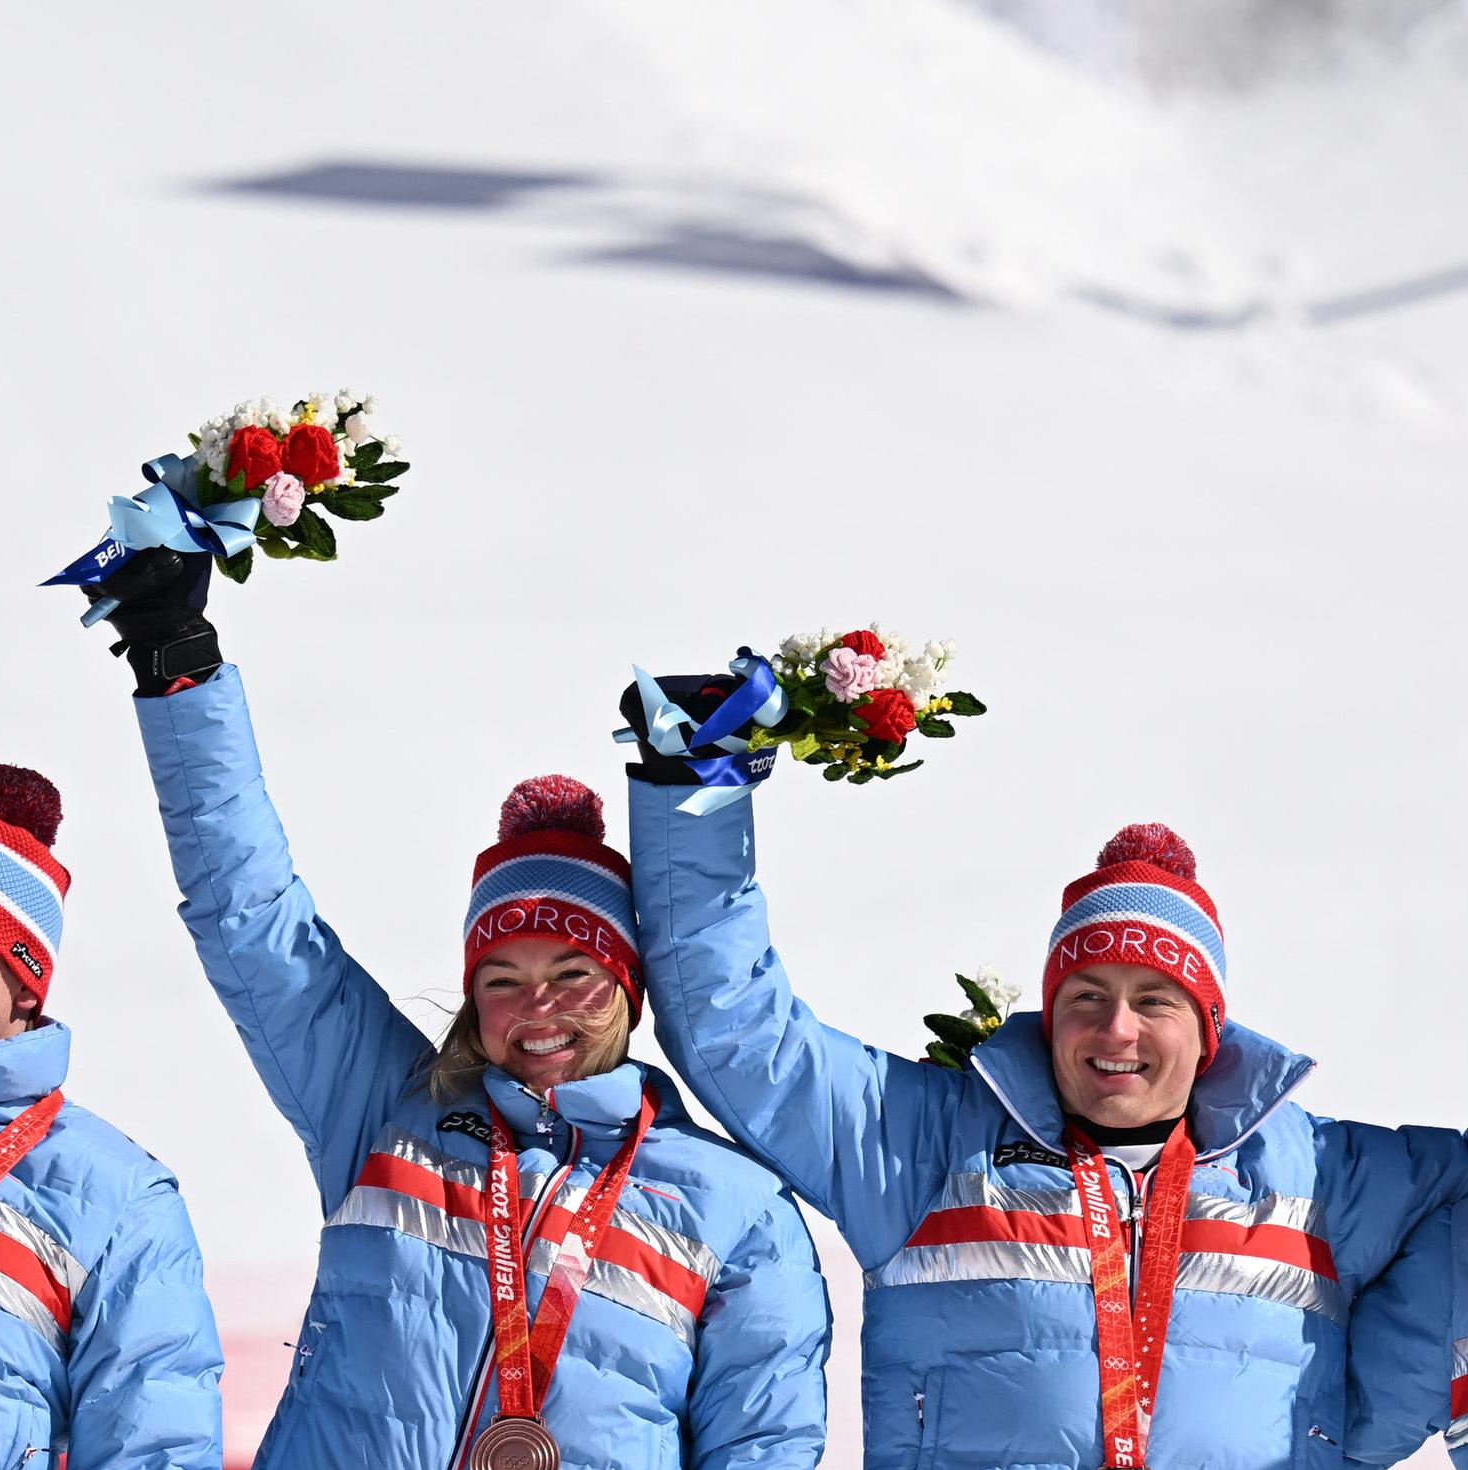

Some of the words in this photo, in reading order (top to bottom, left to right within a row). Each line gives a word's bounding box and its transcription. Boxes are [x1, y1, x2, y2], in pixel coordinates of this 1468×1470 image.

[93, 540, 126, 569] BEIJ
[475, 905, 613, 960] NORGE
[1059, 927, 1202, 984] NORGE
[491, 1165, 512, 1220] 2022
[1080, 1170, 1112, 1239] BEIJING
[493, 1224, 518, 1302] BEIJING
